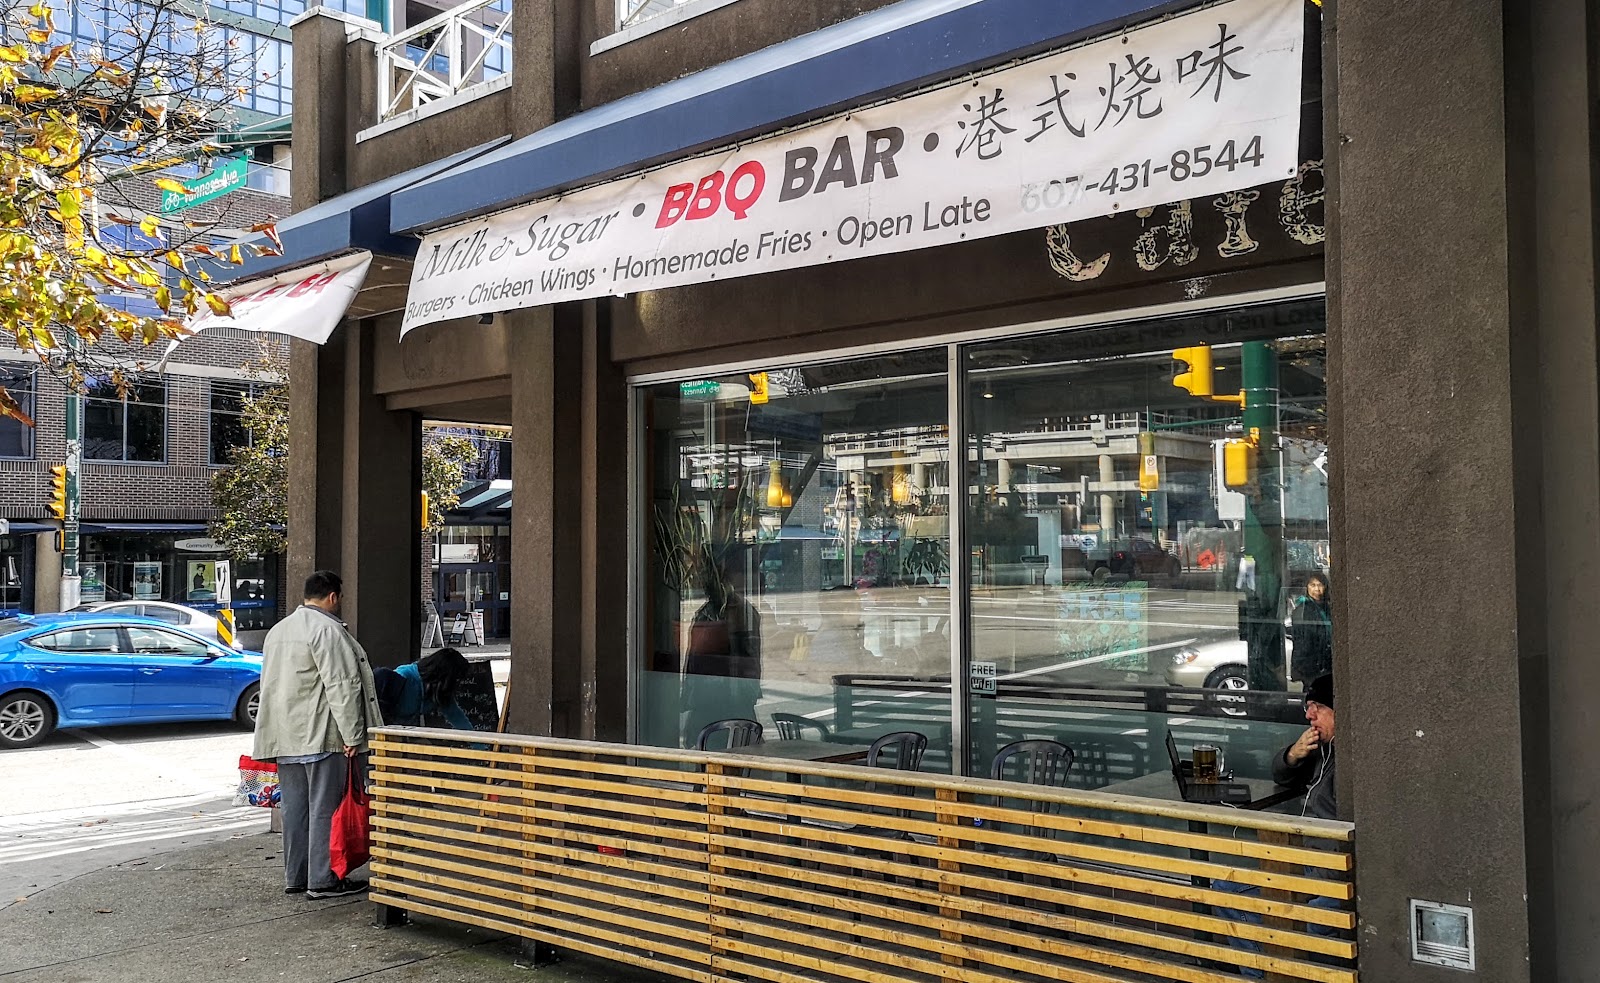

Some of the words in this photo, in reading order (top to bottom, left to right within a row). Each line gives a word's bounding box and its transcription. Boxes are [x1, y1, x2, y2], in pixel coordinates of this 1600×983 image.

[955, 23, 1251, 161] 港式烧味
[405, 294, 455, 323] Burgers
[468, 277, 534, 306] Chicken
[540, 267, 596, 293] Wings
[612, 239, 749, 281] Homemade
[756, 229, 813, 260] Fries
[837, 214, 912, 247] Open
[923, 196, 991, 231] Late
[417, 227, 490, 282] Milk
[489, 239, 514, 262] &
[516, 211, 620, 261] Sugar
[654, 160, 766, 229] BBQ
[778, 126, 905, 203] BAR
[971, 664, 994, 675] FREE
